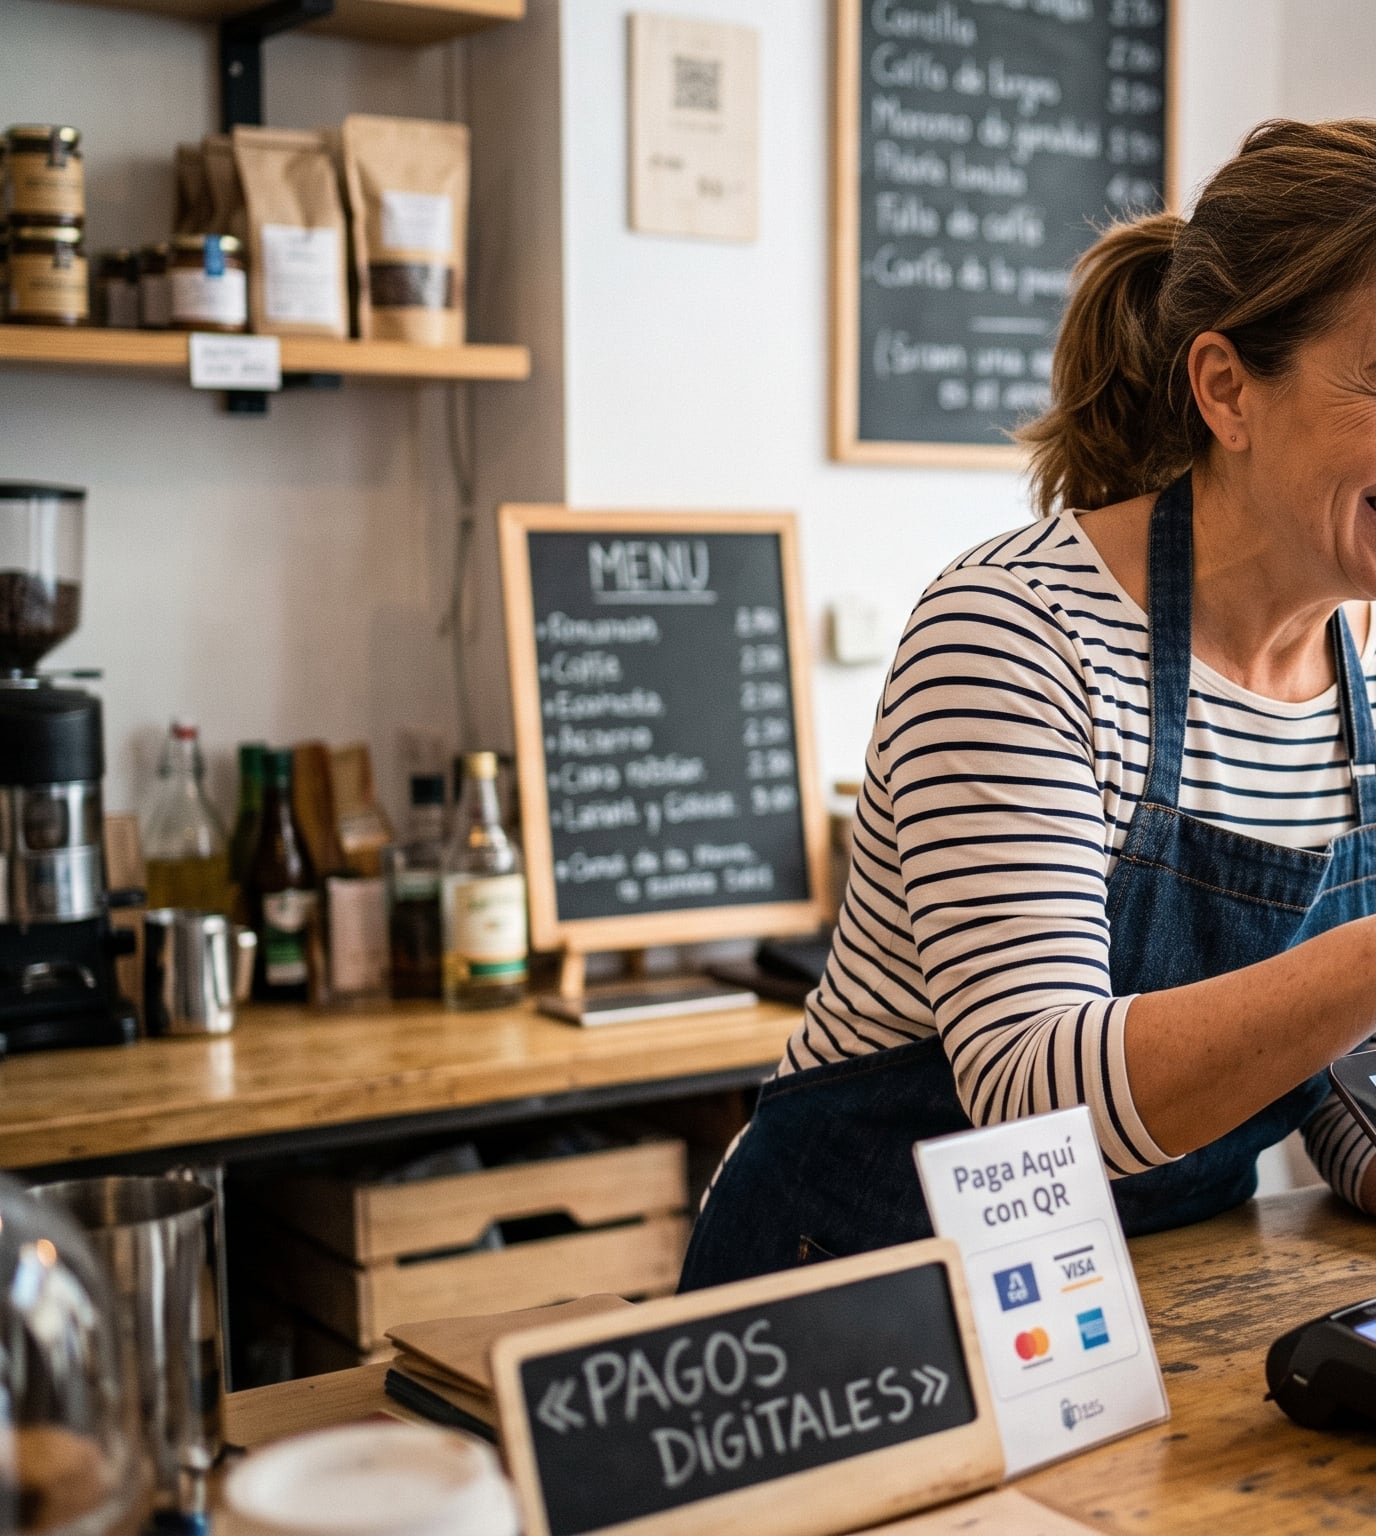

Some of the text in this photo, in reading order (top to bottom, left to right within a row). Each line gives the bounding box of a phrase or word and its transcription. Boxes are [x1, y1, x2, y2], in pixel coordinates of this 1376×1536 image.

[588, 540, 711, 592] MENU
[953, 1135, 1076, 1193] Paga Aquí
[983, 1182, 1070, 1226] con QR
[1061, 1257, 1096, 1280] VISA
